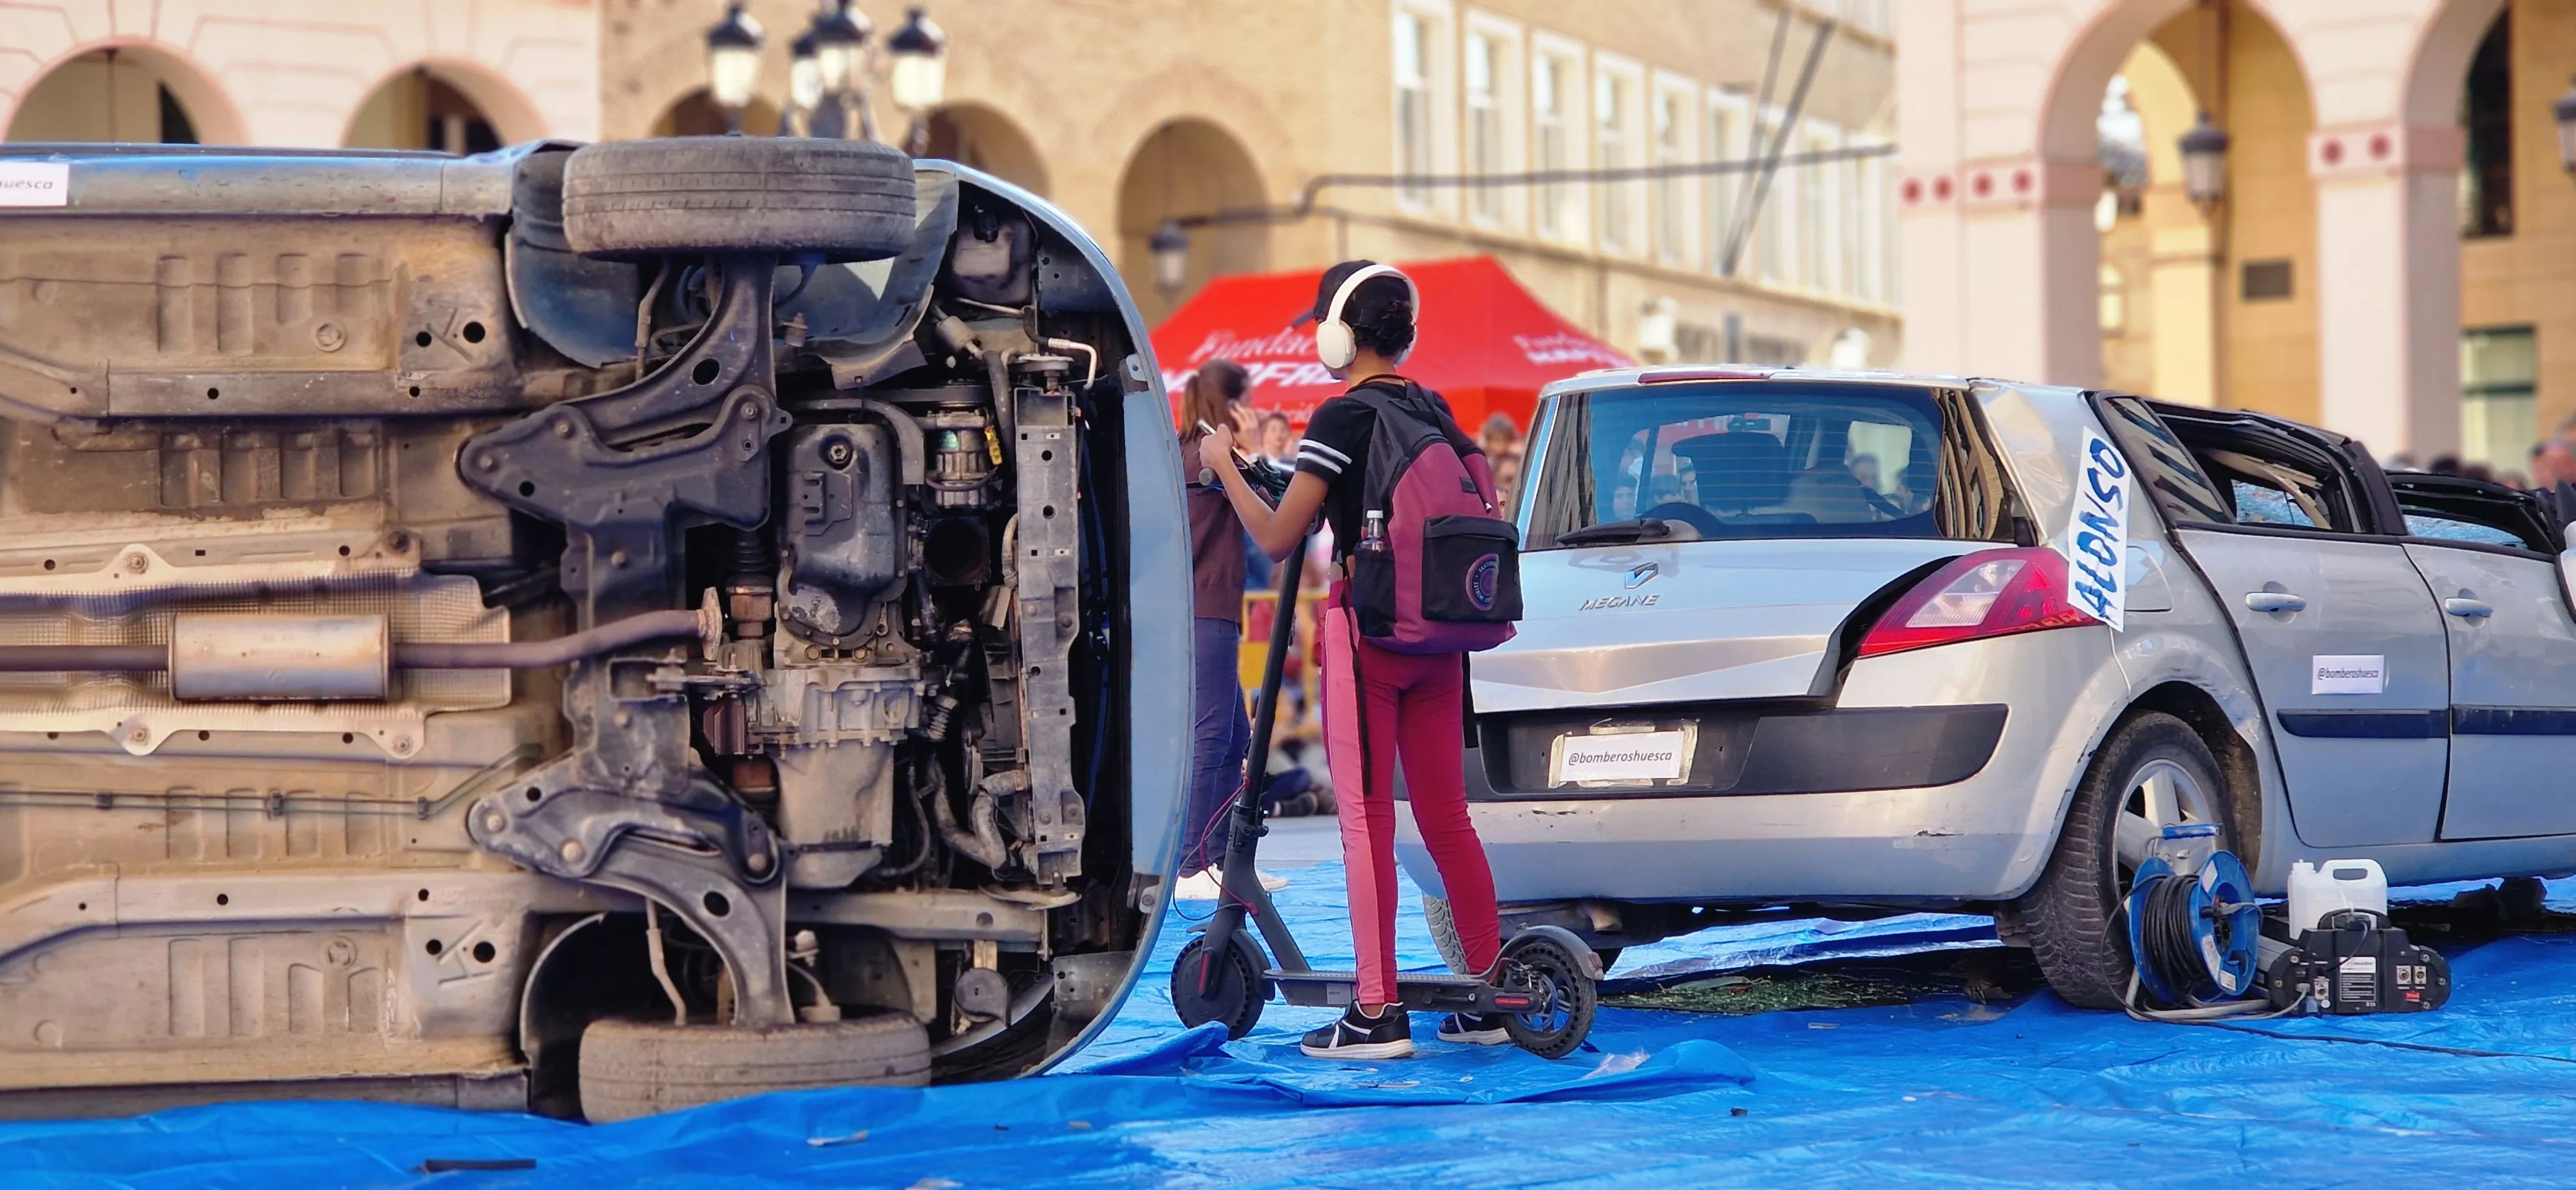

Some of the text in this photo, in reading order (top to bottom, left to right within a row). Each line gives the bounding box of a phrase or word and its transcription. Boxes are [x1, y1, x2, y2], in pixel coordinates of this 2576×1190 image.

[0, 180, 53, 189] uesca
[1190, 327, 1318, 363] Fundac
[2075, 438, 2125, 626] ALONSO
[1579, 594, 1660, 610] MEGANE
[2318, 667, 2380, 680] @bomberoshuesca
[1568, 750, 1673, 766] @bomberoshuesca
